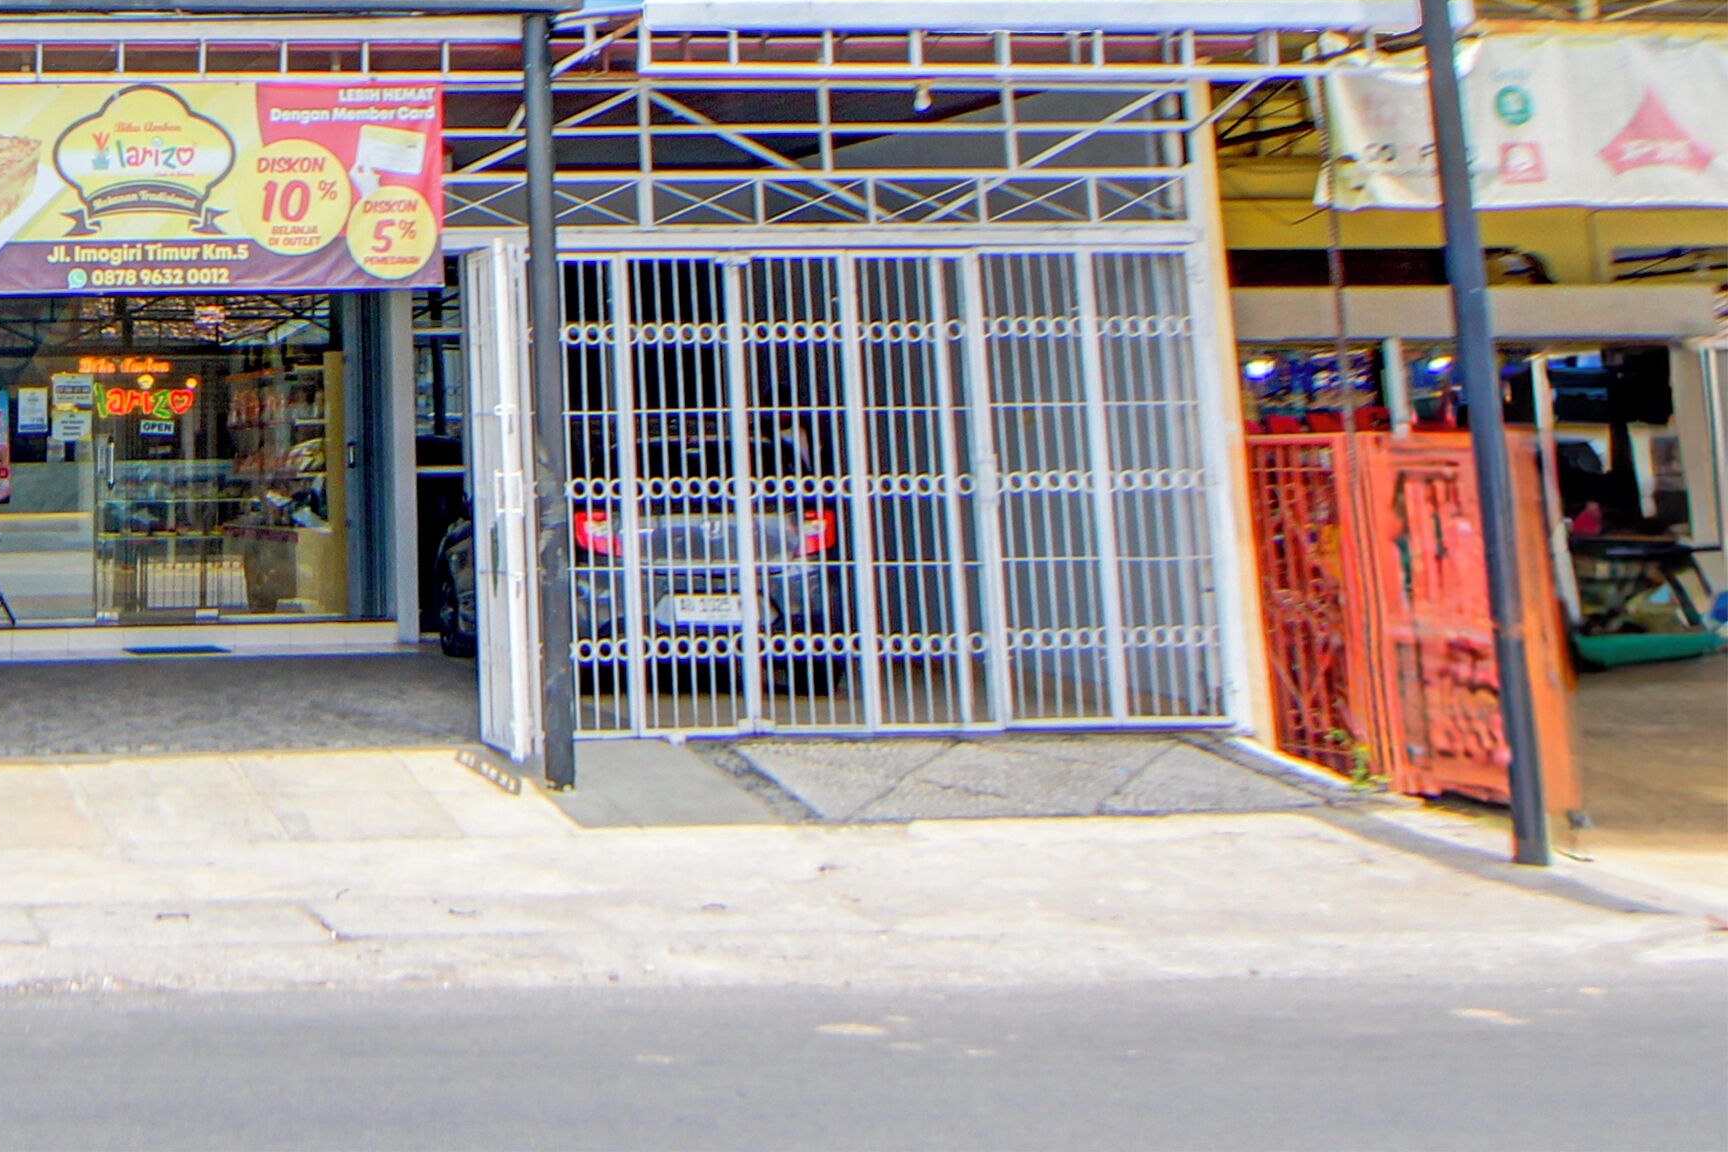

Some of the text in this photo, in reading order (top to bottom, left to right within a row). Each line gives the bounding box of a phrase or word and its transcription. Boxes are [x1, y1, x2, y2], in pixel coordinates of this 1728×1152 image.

[339, 87, 435, 102] LEBIH HEMAT
[270, 106, 436, 124] Dengan Member Card
[116, 140, 195, 169] larizo
[257, 157, 327, 174] DISKON
[363, 199, 418, 215] DISKON
[47, 243, 250, 266] Jl. Imogiri Timur Km.5
[91, 267, 230, 287] 0878 9632 0012
[93, 382, 194, 419] larizo
[143, 421, 173, 433] OPEN
